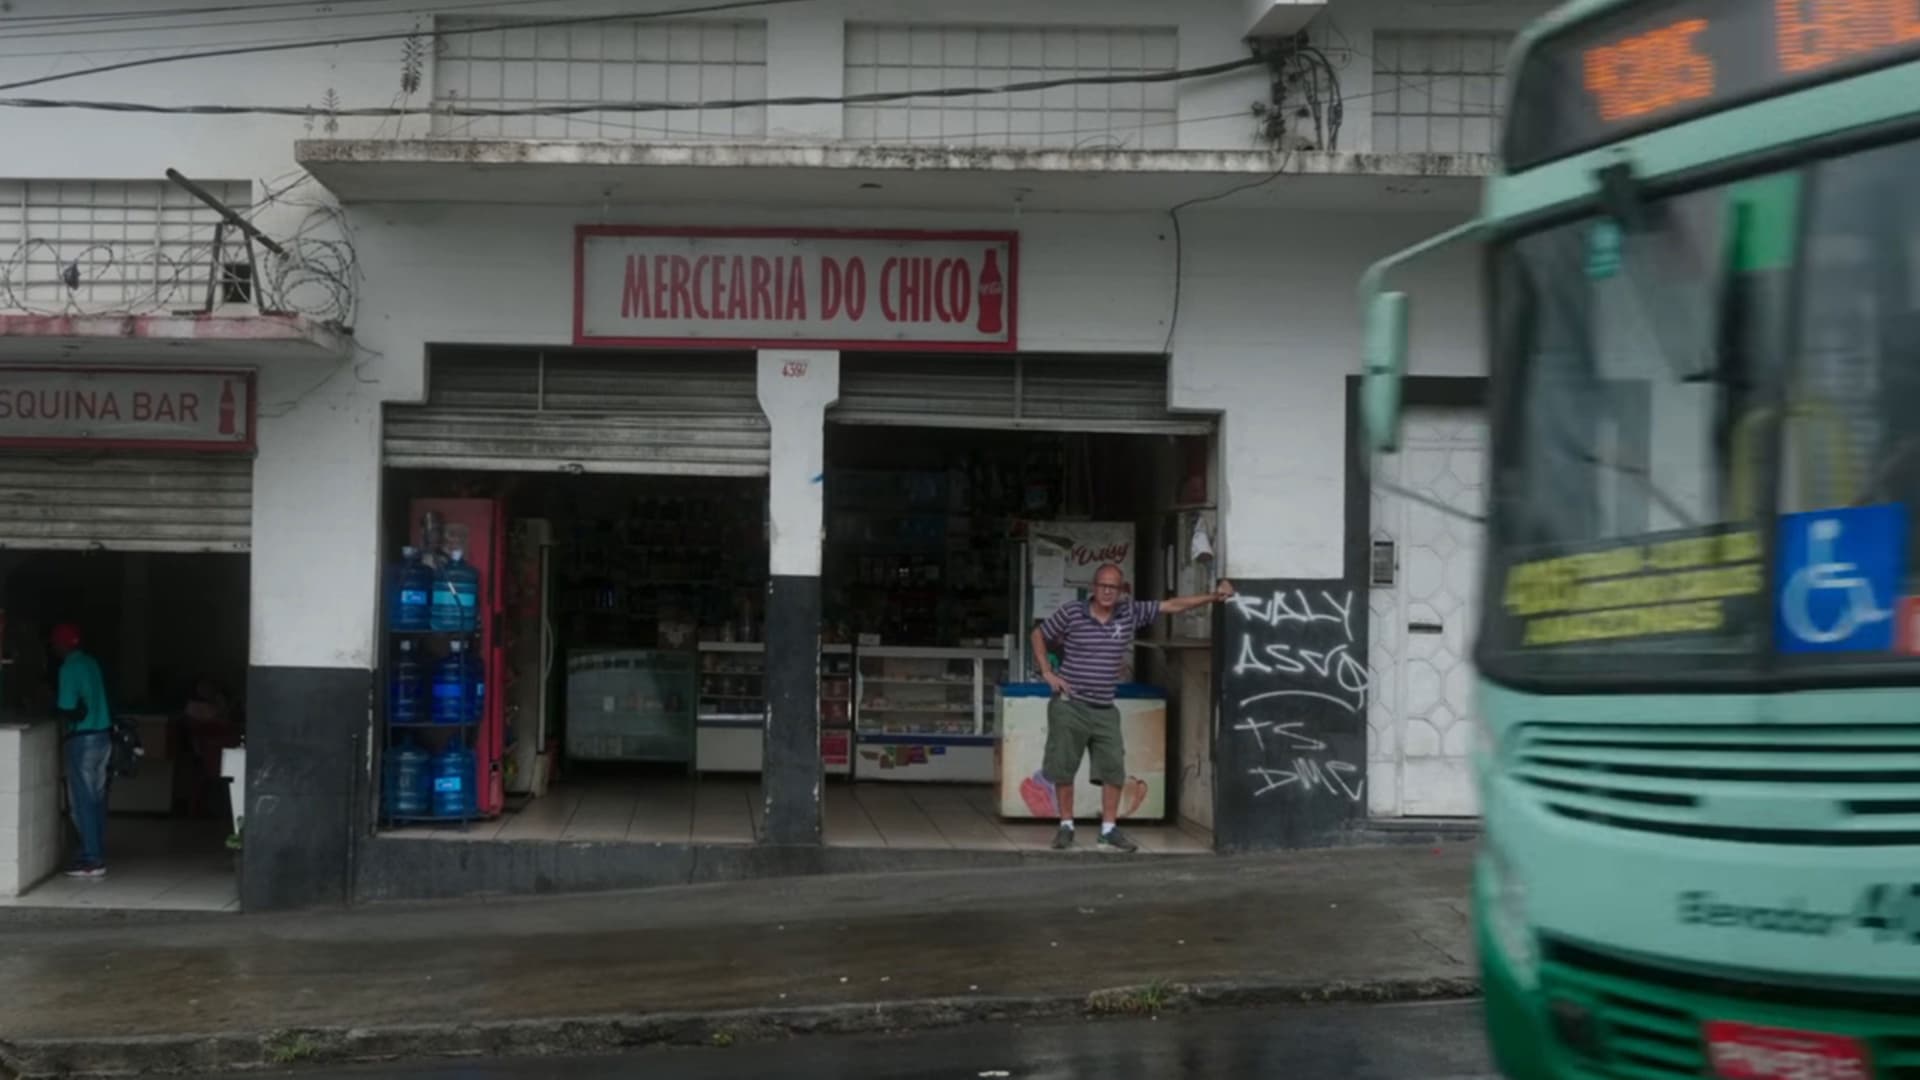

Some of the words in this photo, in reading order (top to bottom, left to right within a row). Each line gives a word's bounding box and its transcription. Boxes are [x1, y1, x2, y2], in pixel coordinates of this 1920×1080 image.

[620, 254, 807, 321] MERCEARIA
[820, 256, 867, 322] DO
[879, 257, 971, 323] CHICO
[132, 391, 199, 422] BAR
